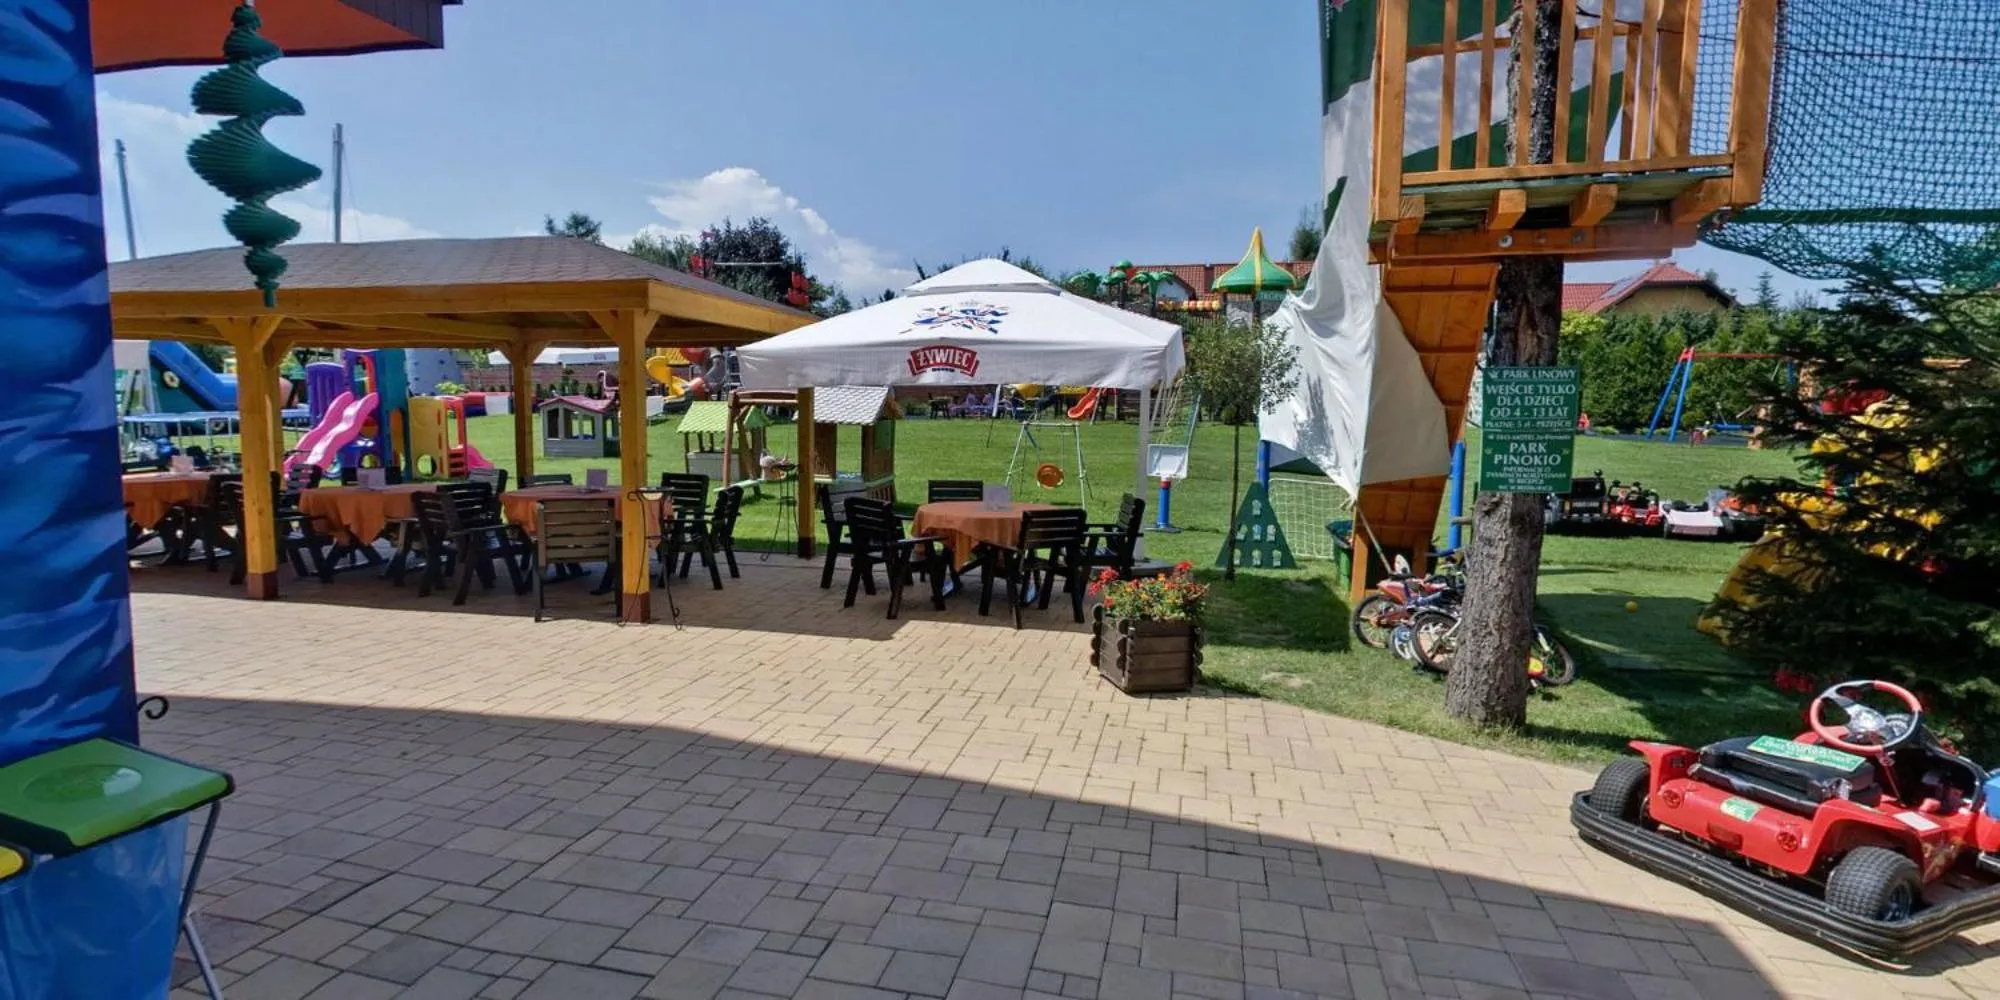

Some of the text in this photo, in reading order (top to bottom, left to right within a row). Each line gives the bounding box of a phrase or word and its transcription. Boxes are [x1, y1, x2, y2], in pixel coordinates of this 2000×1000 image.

[1503, 369, 1577, 379] PARK LINOWY
[1486, 382, 1576, 395] WEJŚCIE TYLKO
[1497, 395, 1564, 406] DLA DZIECI
[1490, 407, 1512, 418] OD
[1513, 407, 1521, 417] 4
[1533, 407, 1546, 417] 13
[1548, 407, 1569, 417] LAT
[1509, 442, 1547, 454] PARK
[1493, 454, 1561, 466] PINOKIO
